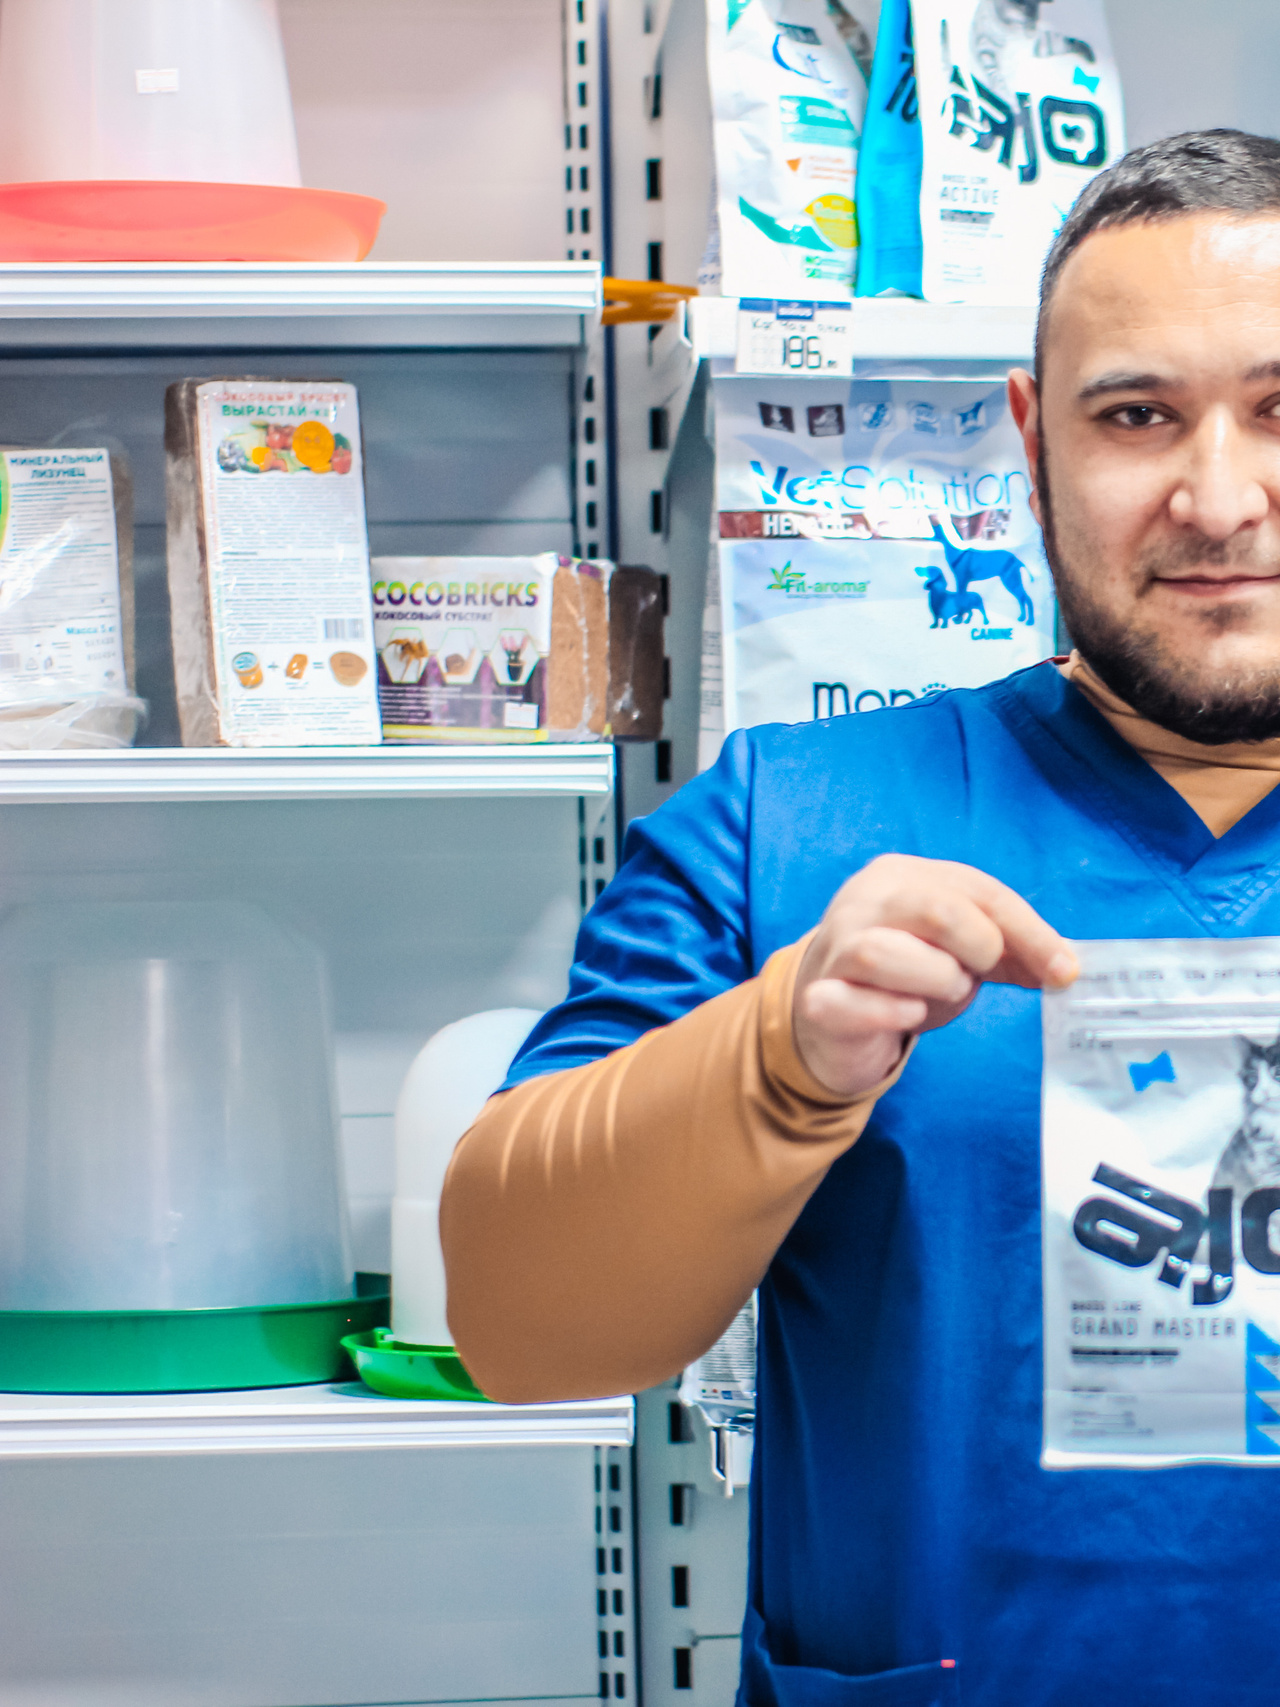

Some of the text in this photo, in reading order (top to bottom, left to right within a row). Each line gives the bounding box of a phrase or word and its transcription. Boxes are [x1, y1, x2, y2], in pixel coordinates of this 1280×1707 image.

[940, 186, 999, 205] ACTIVE
[782, 335, 822, 369] 186
[373, 580, 539, 607] COCOBRICKS
[1071, 1316, 1237, 1339] GRAND MASTER
